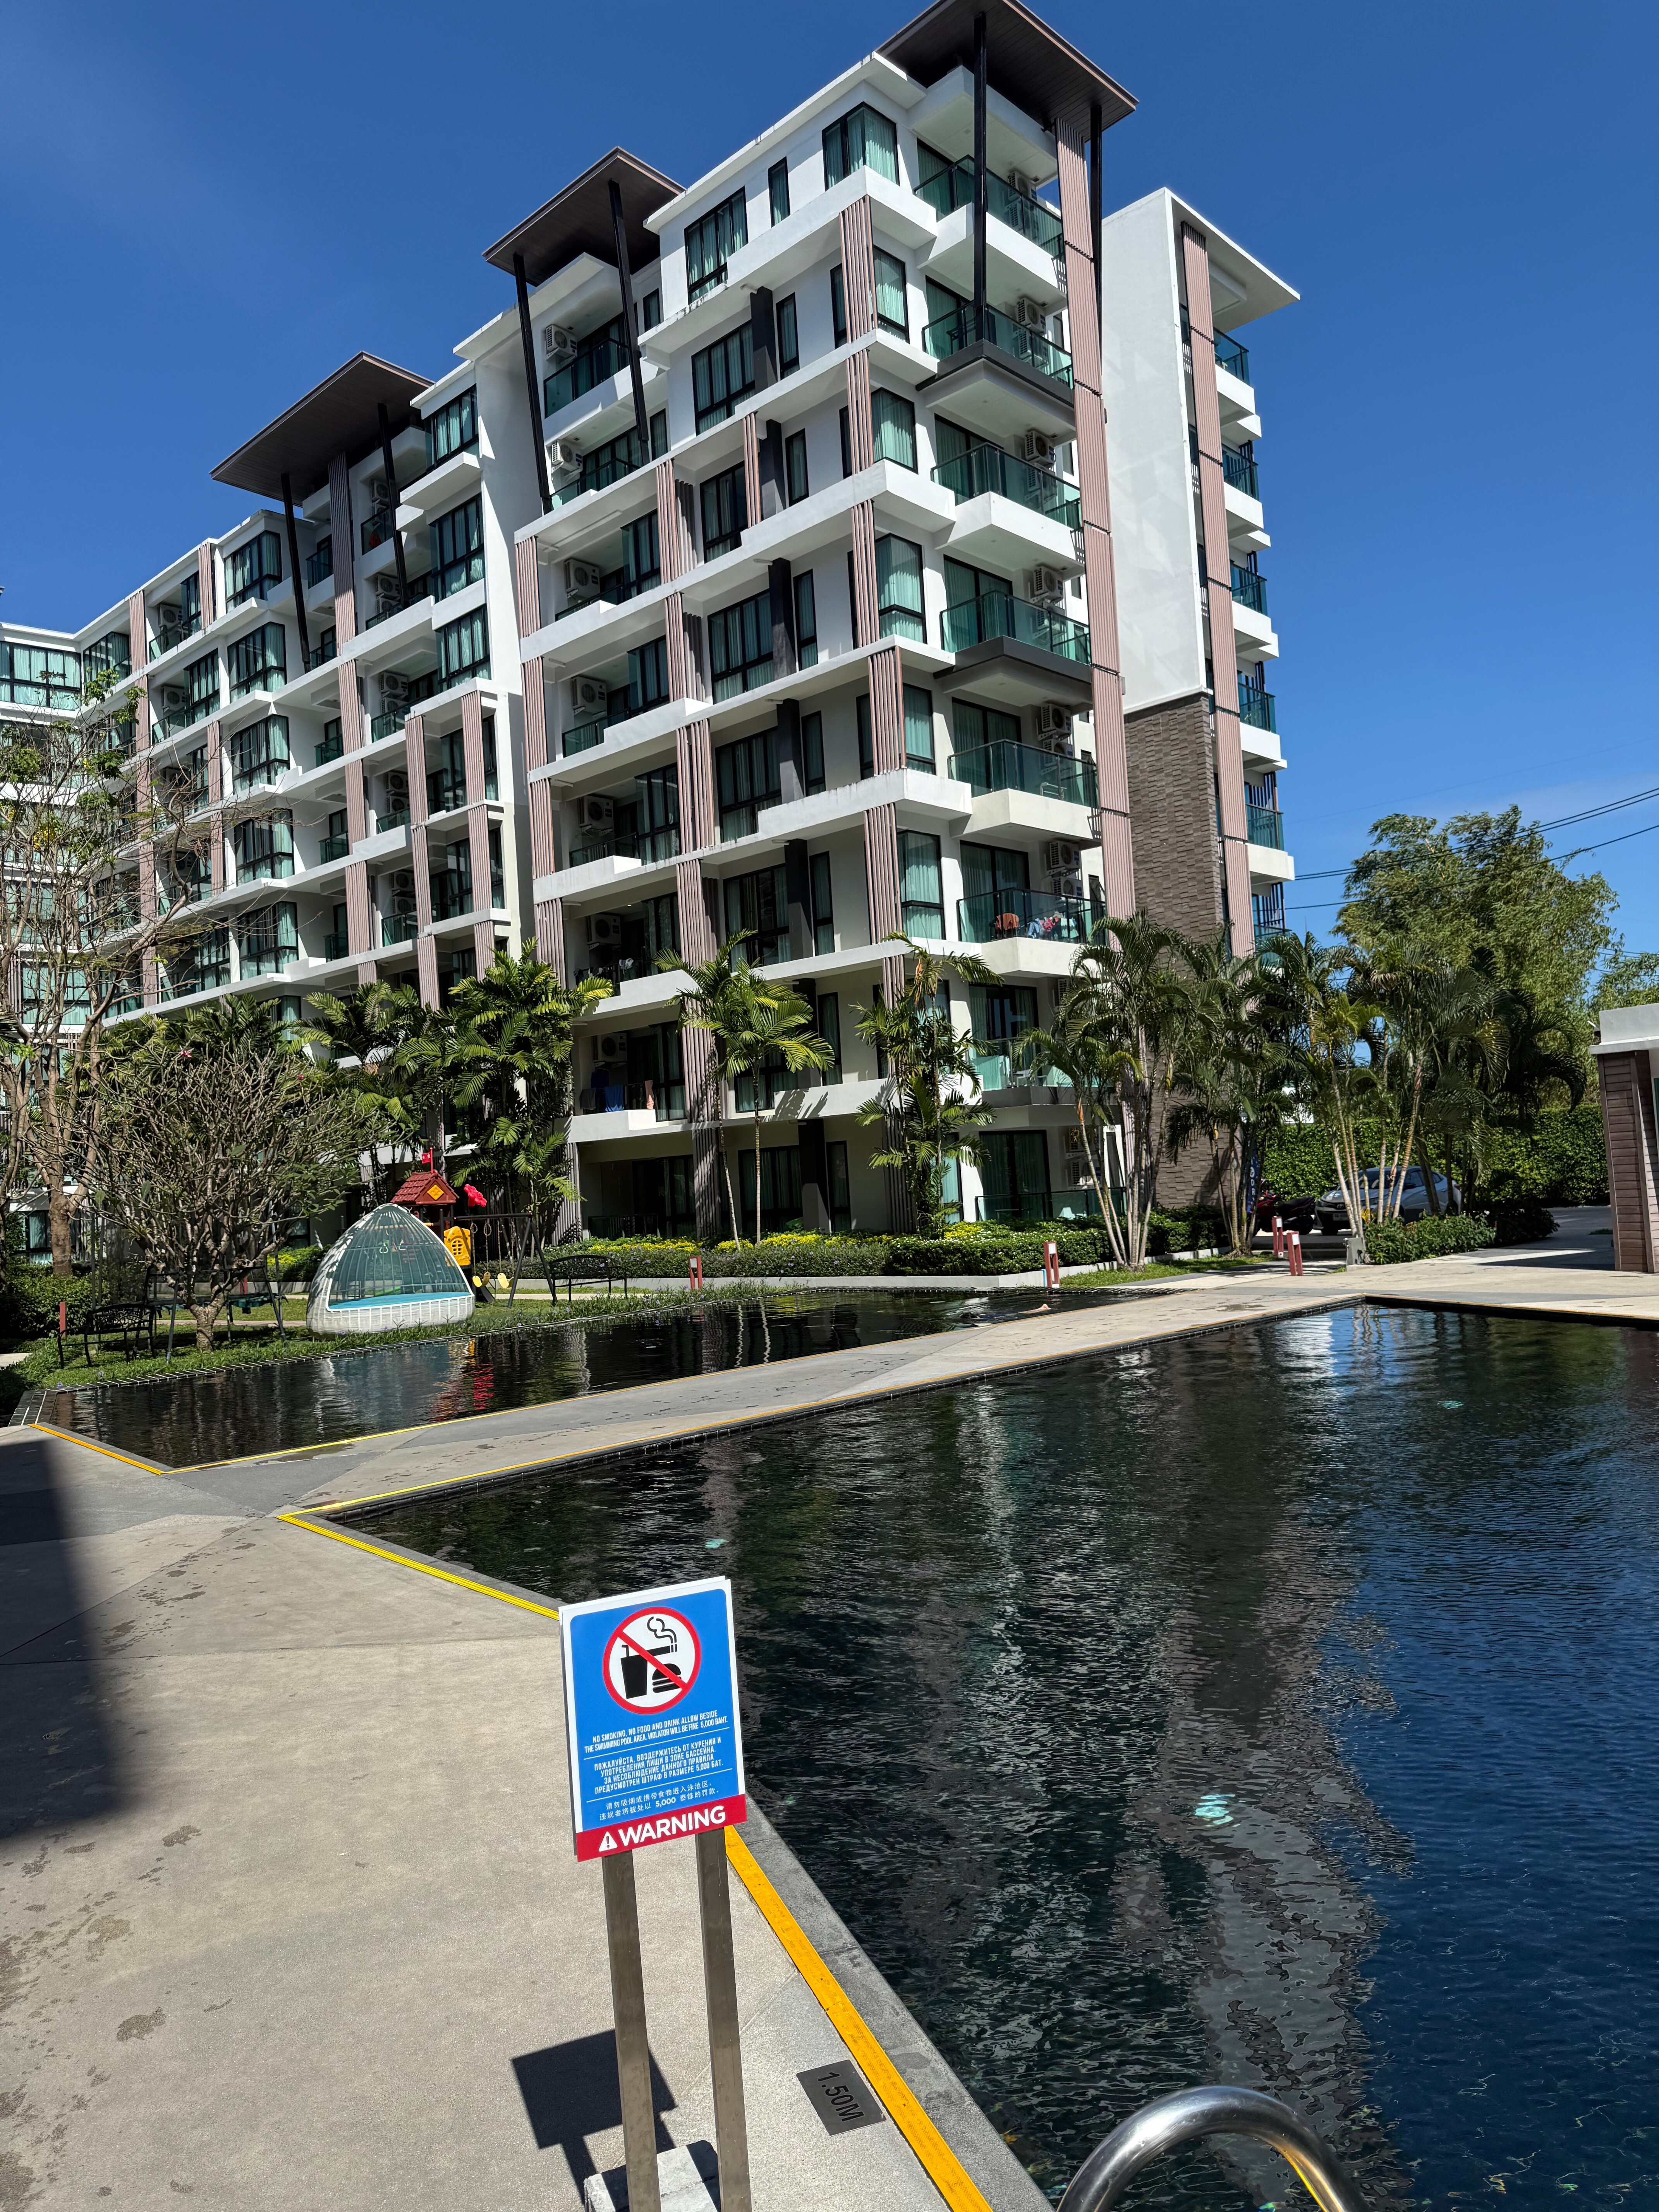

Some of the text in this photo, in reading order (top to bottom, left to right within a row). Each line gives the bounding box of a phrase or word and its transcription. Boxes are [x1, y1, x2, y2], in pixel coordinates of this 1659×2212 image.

[584, 1745, 594, 1753] THE
[594, 1740, 620, 1751] SWIMMING
[621, 1737, 633, 1745] POOL
[647, 1729, 670, 1740] VIOLATOR
[670, 1726, 681, 1735] WILL
[689, 1722, 699, 1731] FINE
[701, 1718, 714, 1728] 5,000
[715, 1716, 728, 1725] BAHT.
[592, 1735, 600, 1743] NO
[601, 1729, 627, 1741] SMOKING,
[637, 1724, 651, 1734] FOOD
[652, 1722, 663, 1730] AND
[664, 1718, 680, 1728] DRINK
[681, 1714, 698, 1724] ALLOW
[700, 1710, 718, 1720] BESIDE
[601, 1761, 645, 1778] УПОТРЕБЛЕНИЯ
[646, 1757, 663, 1767] ПИЩИ
[670, 1752, 685, 1762] ЗОНЕ
[637, 1746, 681, 1762] ВОЗДЕРЖИТЕСЬ
[683, 1743, 690, 1751] ОТ
[691, 1738, 716, 1749] КУРЕНИЯ
[595, 1778, 640, 1794] ПРЕДУСМОТРЕН
[641, 1773, 662, 1784] ШТРАФ
[669, 1765, 694, 1778] РАЗМЕРЕ
[696, 1762, 710, 1772] 5,000
[711, 1759, 723, 1768] БАТ.
[613, 1766, 659, 1782] НЕСОБЛЮДЕНИЕ
[661, 1759, 687, 1772] ДАННОГО
[688, 1753, 714, 1765] ПРАВИЛА
[655, 1797, 676, 1808] 5,000
[618, 1805, 726, 1846] WARNING
[817, 2072, 865, 2122] 1.50M
